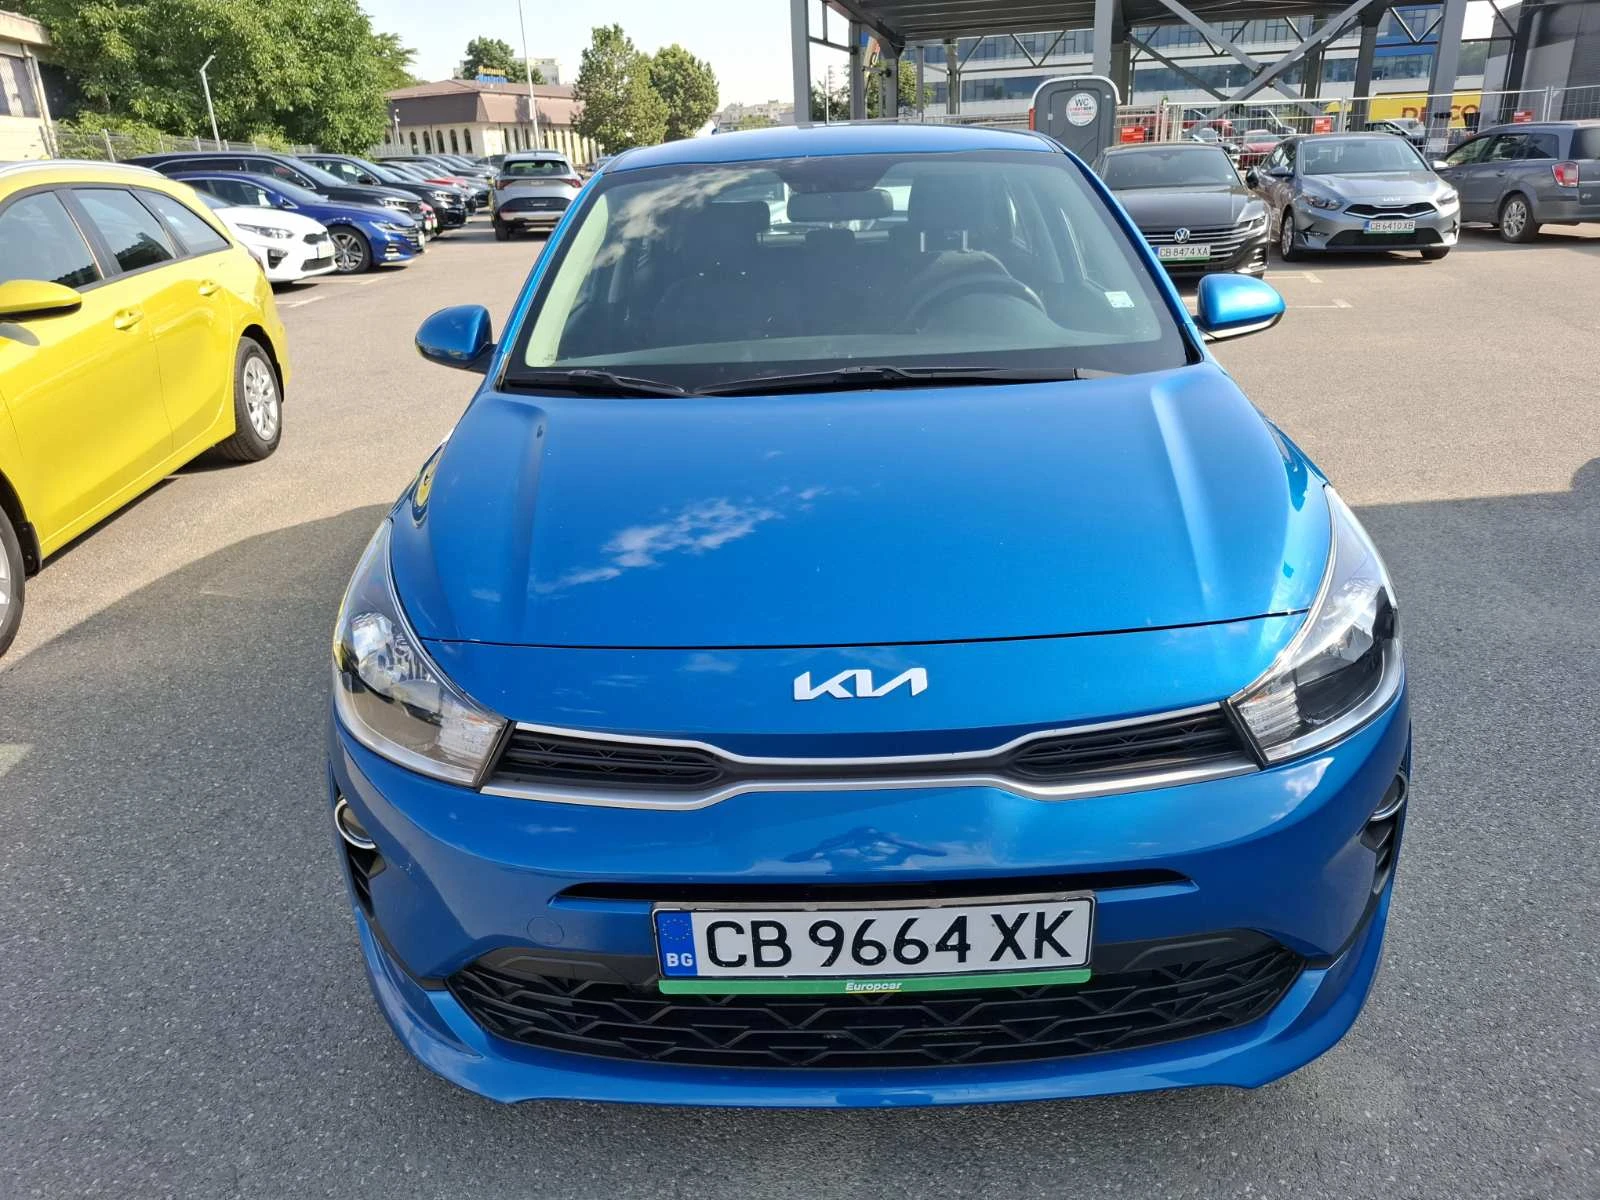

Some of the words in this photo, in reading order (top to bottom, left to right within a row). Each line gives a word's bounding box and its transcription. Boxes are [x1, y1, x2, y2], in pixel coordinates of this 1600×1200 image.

[1173, 247, 1195, 257] 8474
[794, 667, 928, 700] KIA
[706, 919, 792, 968] CB
[808, 915, 971, 968] 9664
[989, 909, 1074, 962] XK
[666, 952, 694, 967] BG
[845, 981, 902, 993] Europcar
